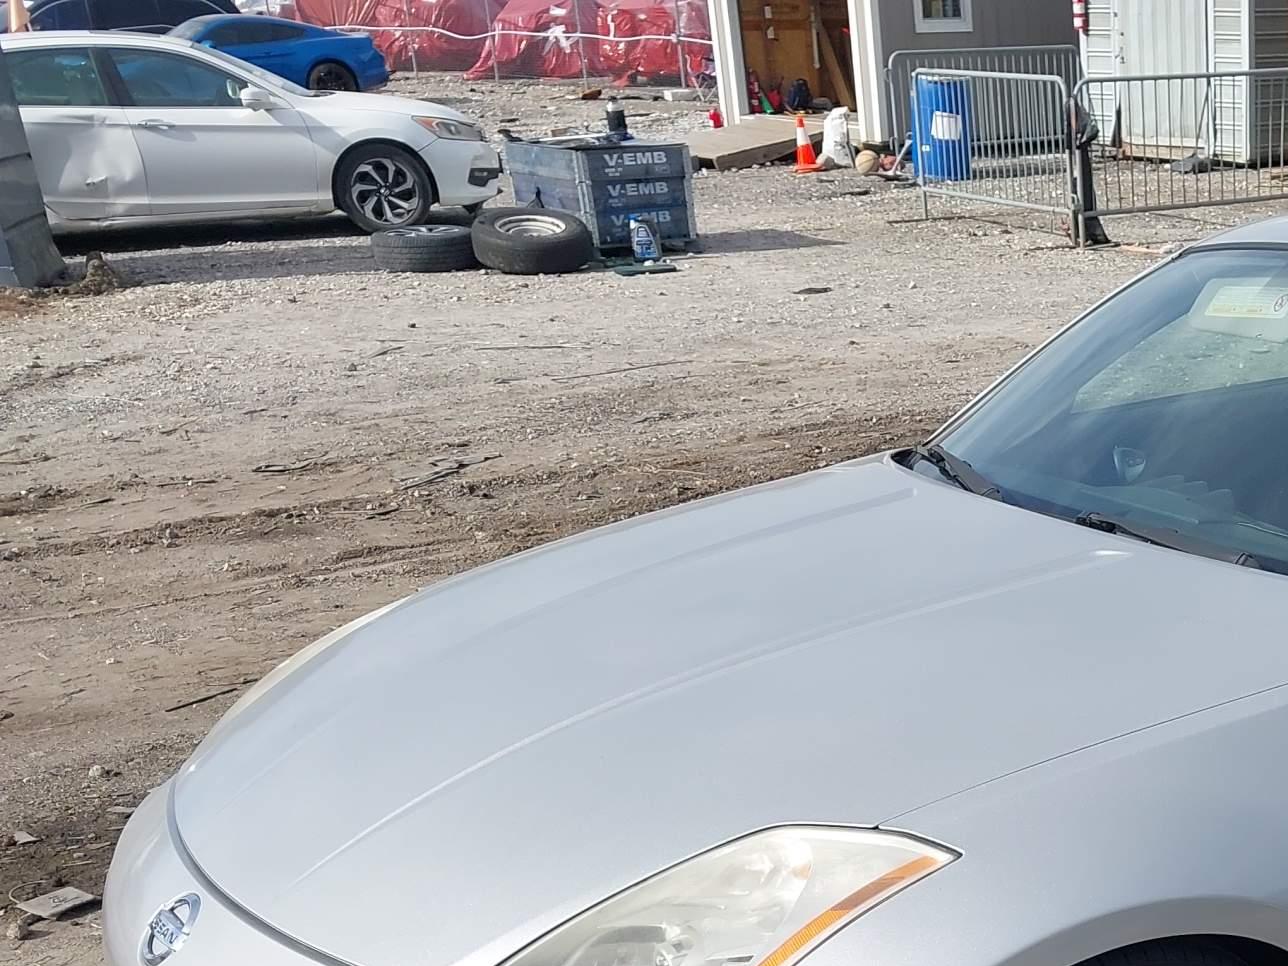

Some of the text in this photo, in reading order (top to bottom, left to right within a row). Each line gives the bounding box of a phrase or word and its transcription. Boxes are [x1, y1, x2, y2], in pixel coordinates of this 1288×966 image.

[604, 151, 667, 167] V-EMB
[607, 182, 669, 197] V-EMB
[611, 211, 672, 226] V-MB
